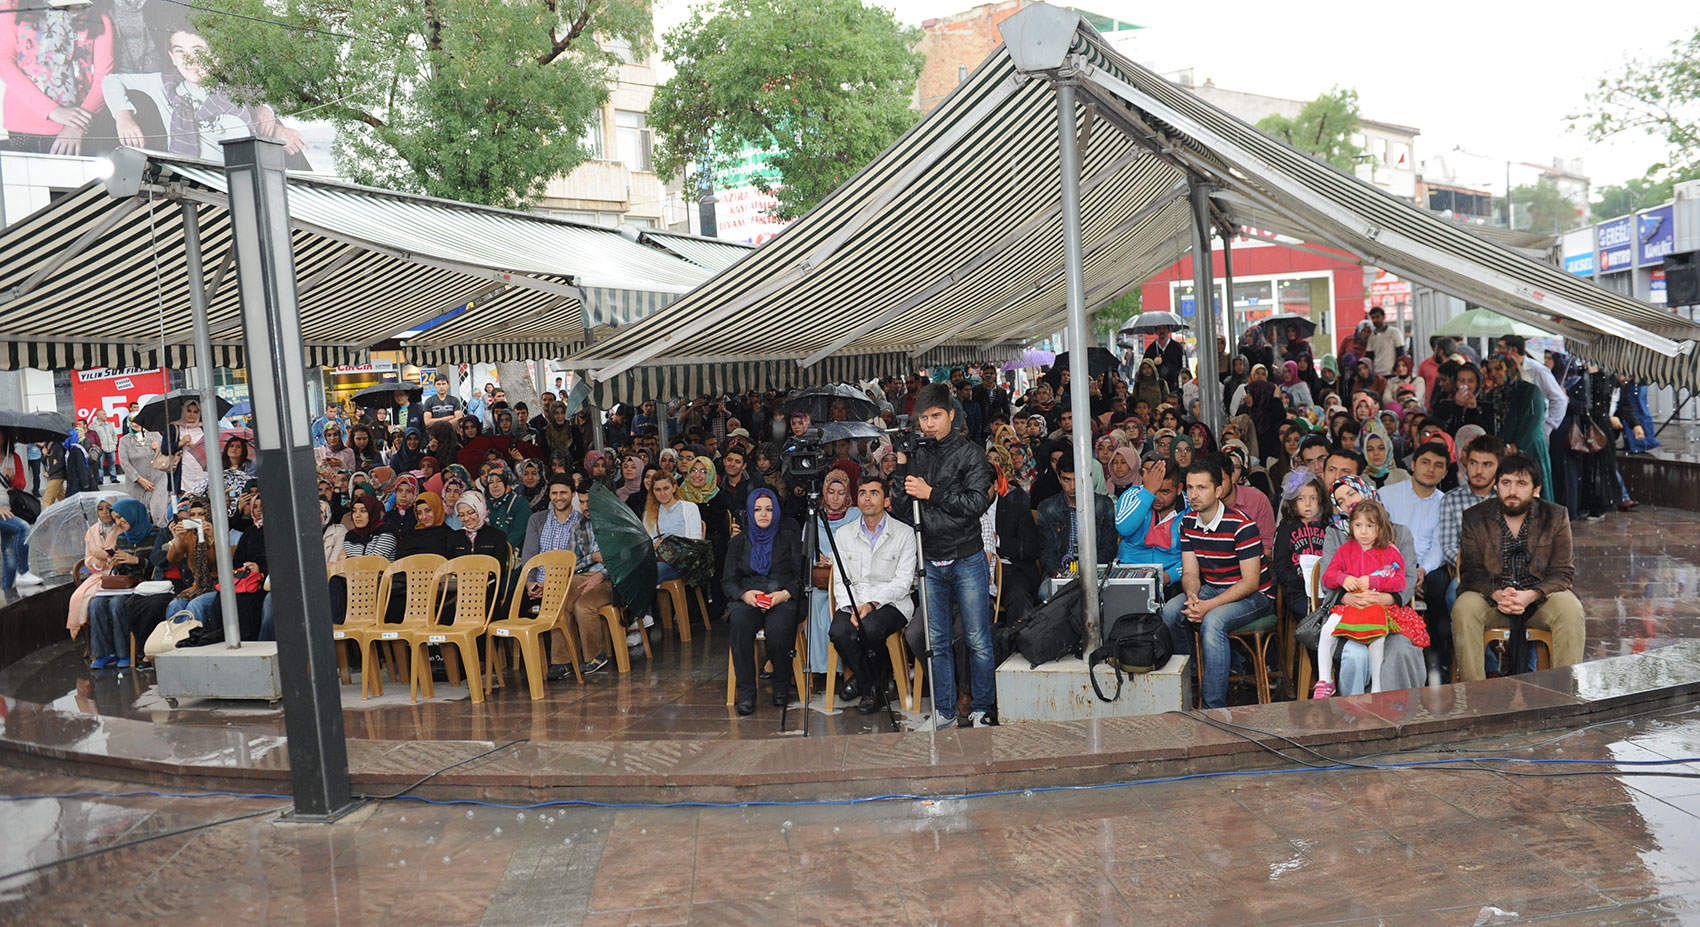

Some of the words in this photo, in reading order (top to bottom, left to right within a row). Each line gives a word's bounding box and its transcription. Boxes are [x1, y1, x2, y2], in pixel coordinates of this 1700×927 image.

[1608, 248, 1631, 266] METRO
[1567, 257, 1593, 272] AKSEL
[81, 371, 103, 380] YILIN
[422, 372, 436, 385] 24
